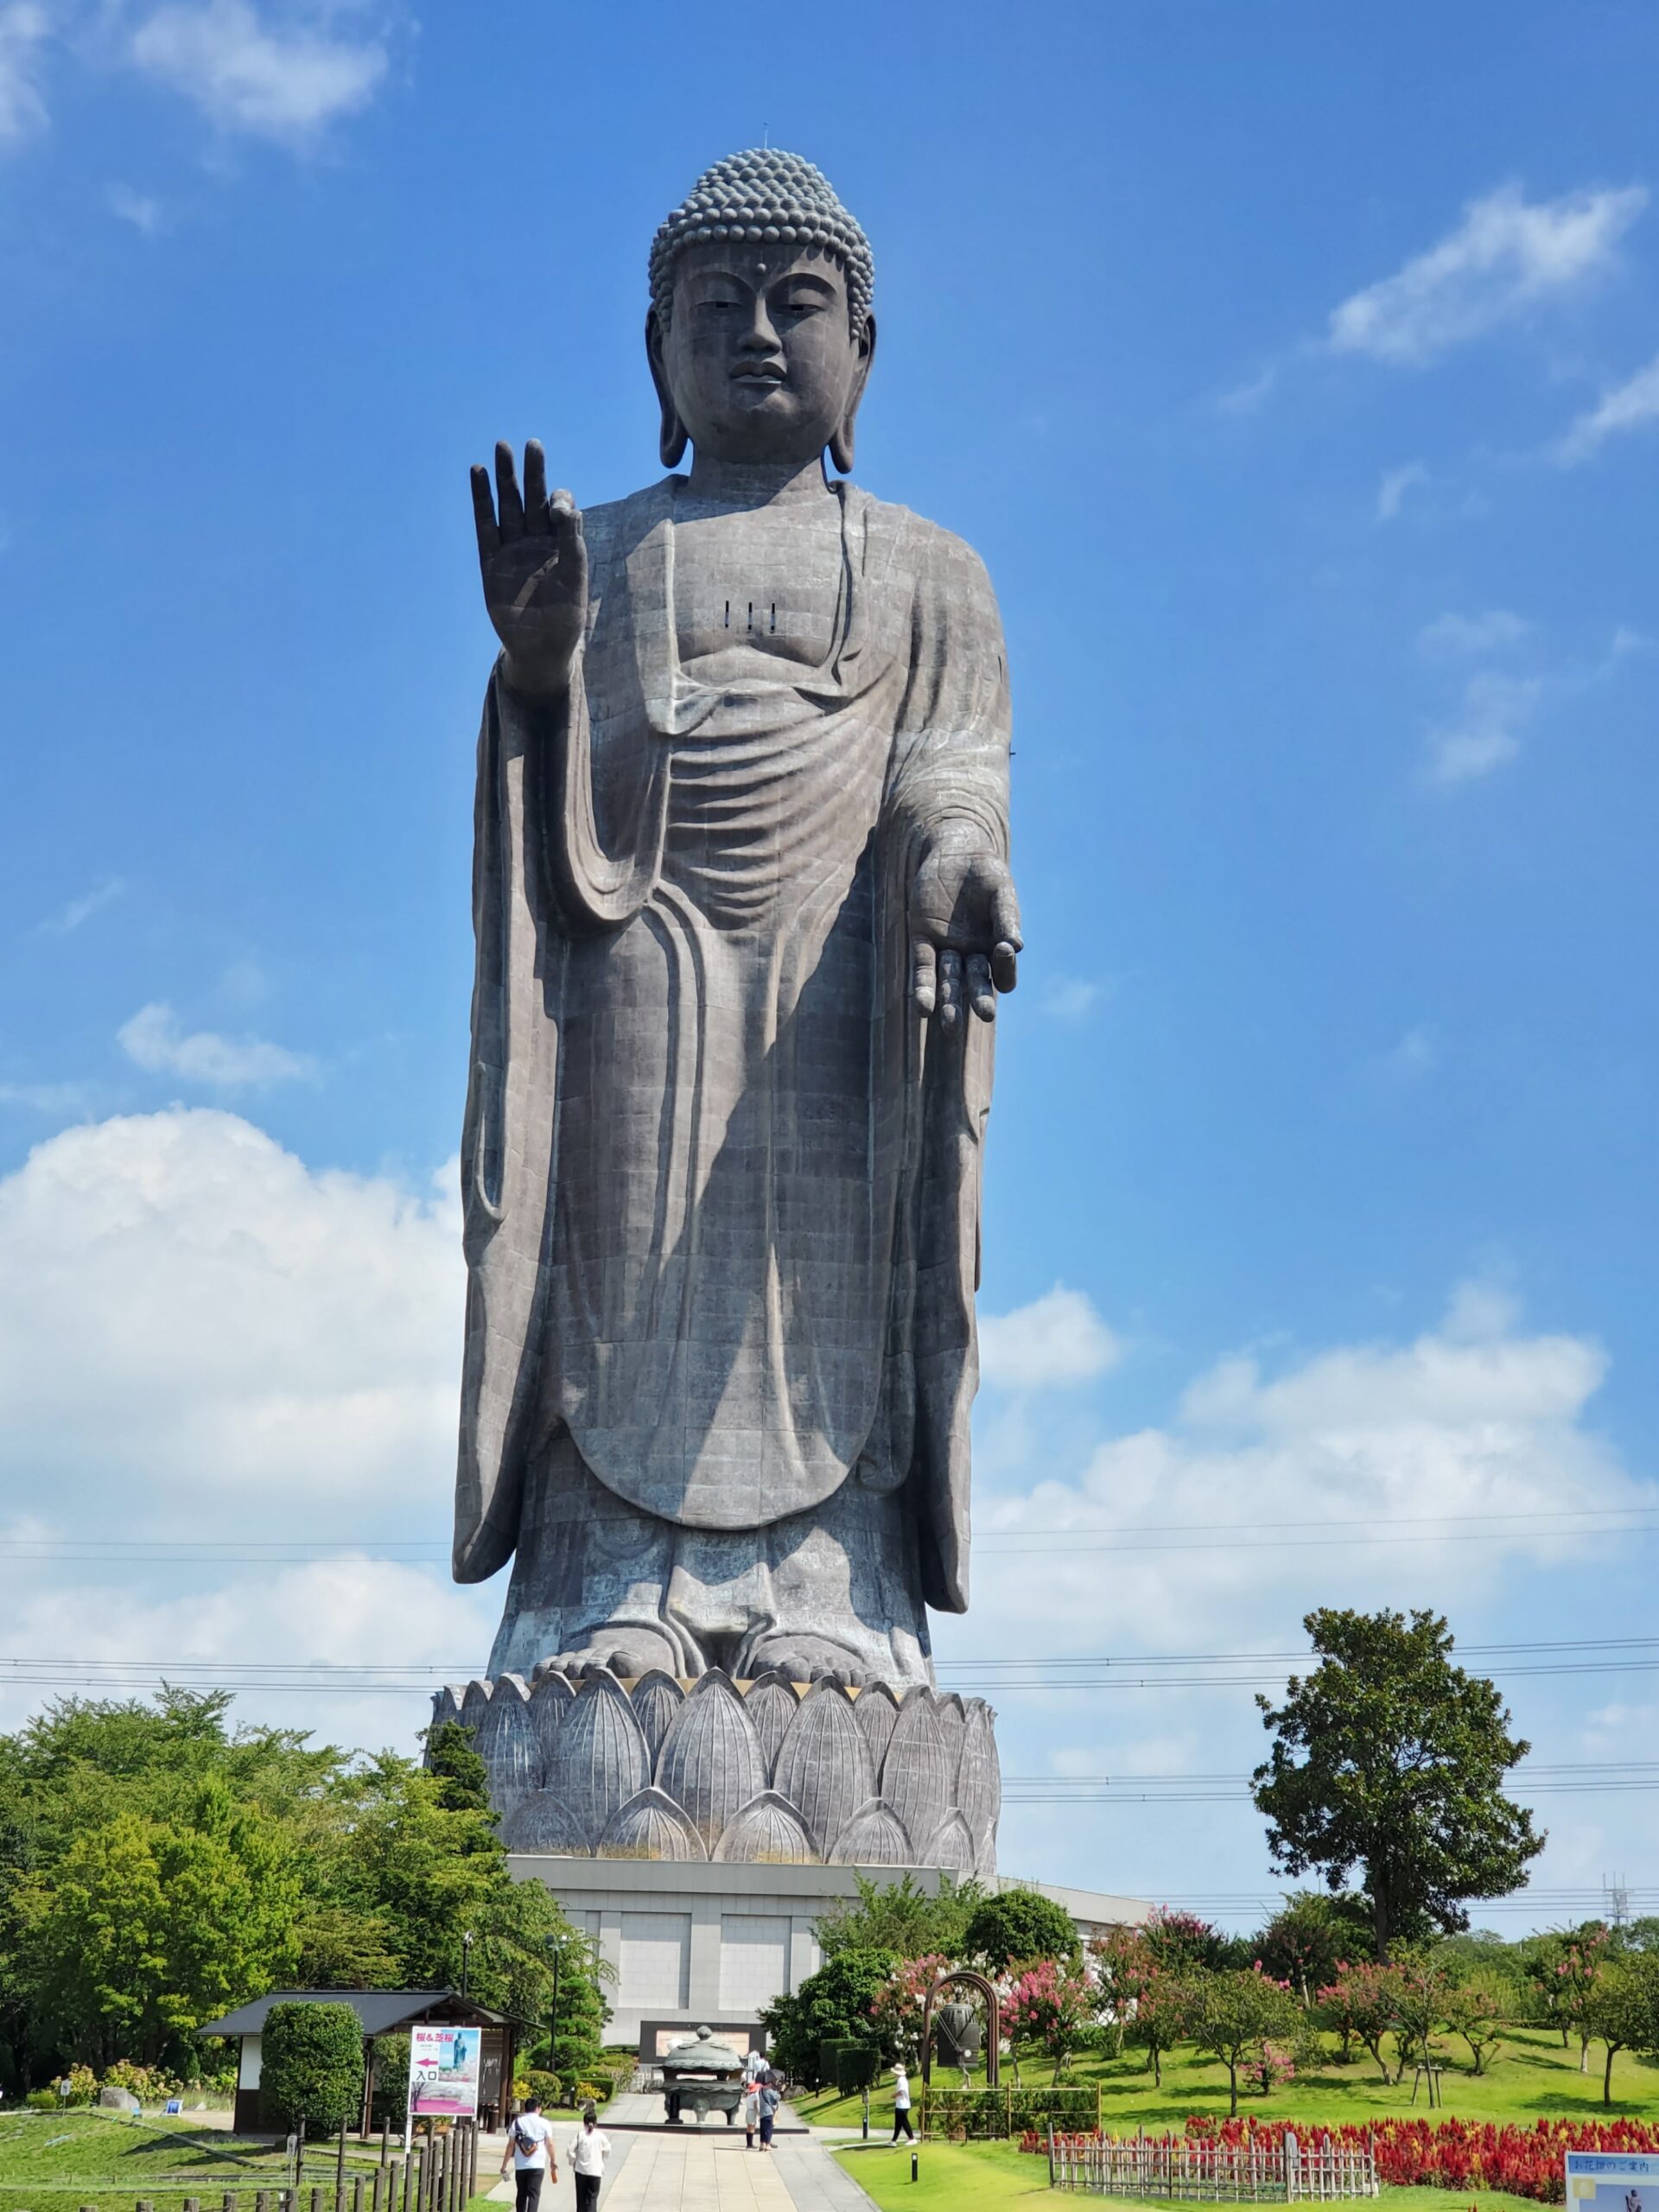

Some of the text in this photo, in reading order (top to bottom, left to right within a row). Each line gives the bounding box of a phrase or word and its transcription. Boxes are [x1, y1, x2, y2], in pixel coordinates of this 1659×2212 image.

[416, 2070, 437, 2081] 入口
[1574, 2159, 1649, 2172] お花畑のご案内
